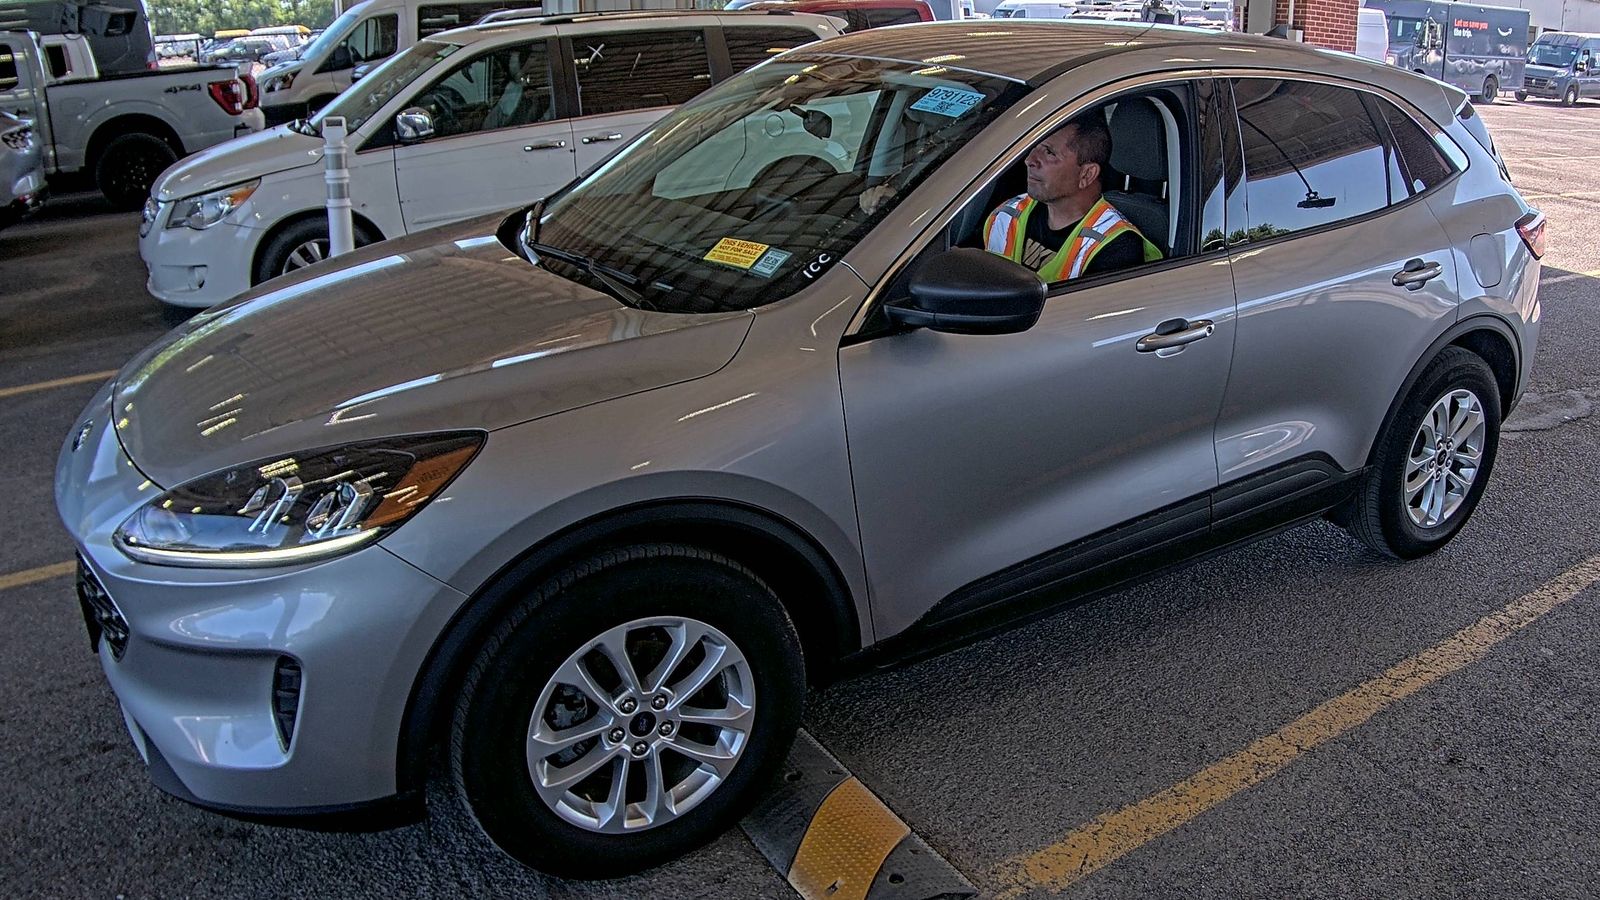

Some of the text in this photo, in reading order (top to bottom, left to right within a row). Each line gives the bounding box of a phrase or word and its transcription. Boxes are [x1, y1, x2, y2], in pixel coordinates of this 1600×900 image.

[928, 88, 981, 106] 9791123
[723, 238, 766, 252] THIS VEHICLE
